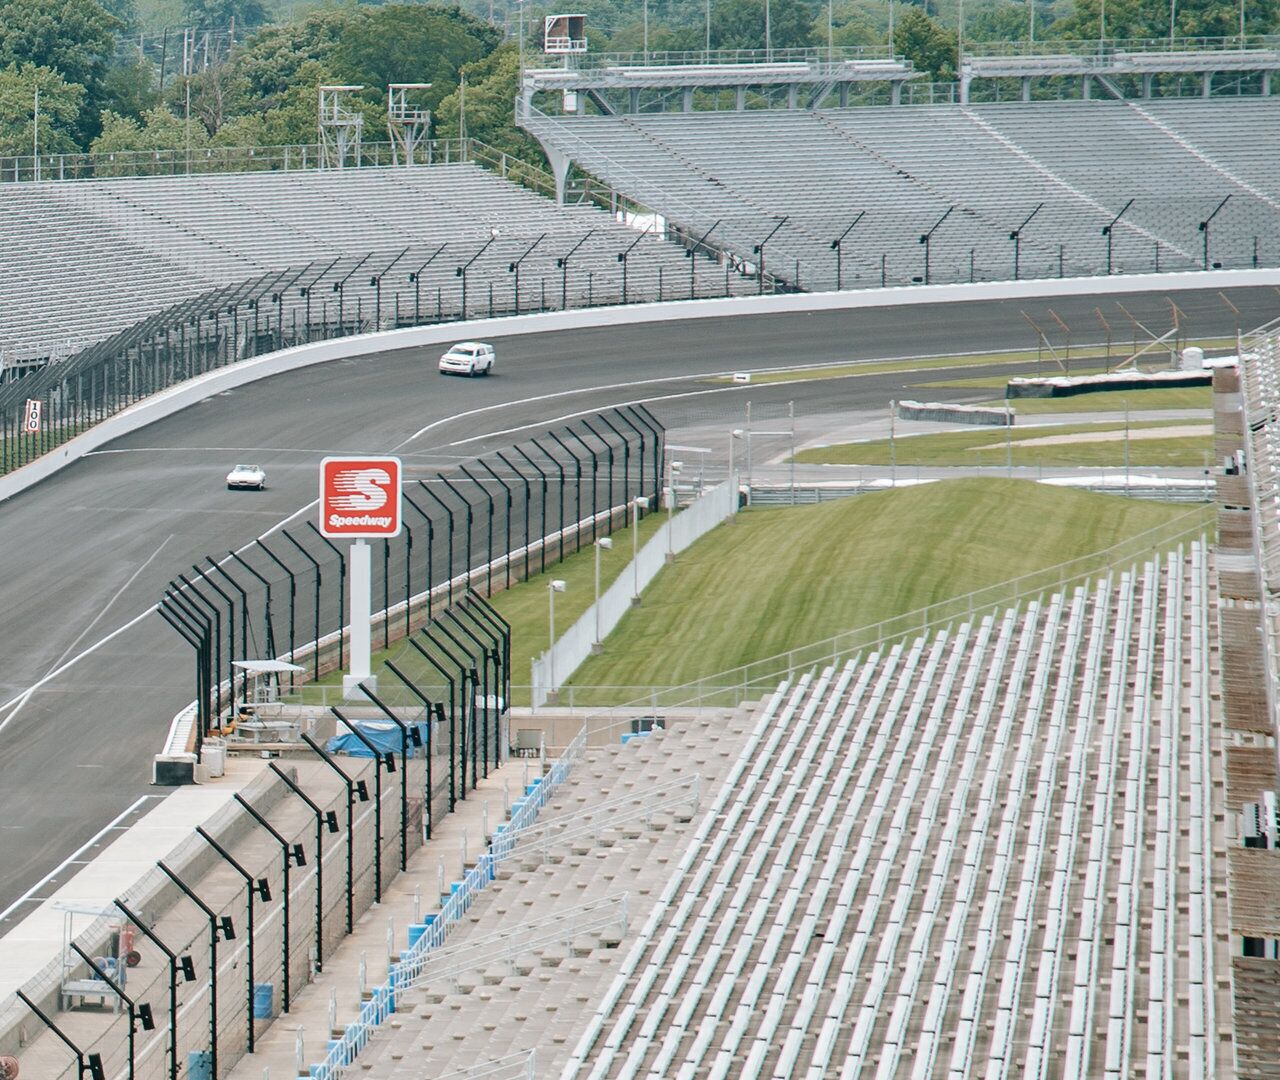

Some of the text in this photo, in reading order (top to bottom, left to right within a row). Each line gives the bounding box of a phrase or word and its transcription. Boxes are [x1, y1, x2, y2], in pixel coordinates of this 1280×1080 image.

[30, 403, 38, 429] 100
[328, 467, 392, 512] S
[329, 514, 392, 528] Speedway
